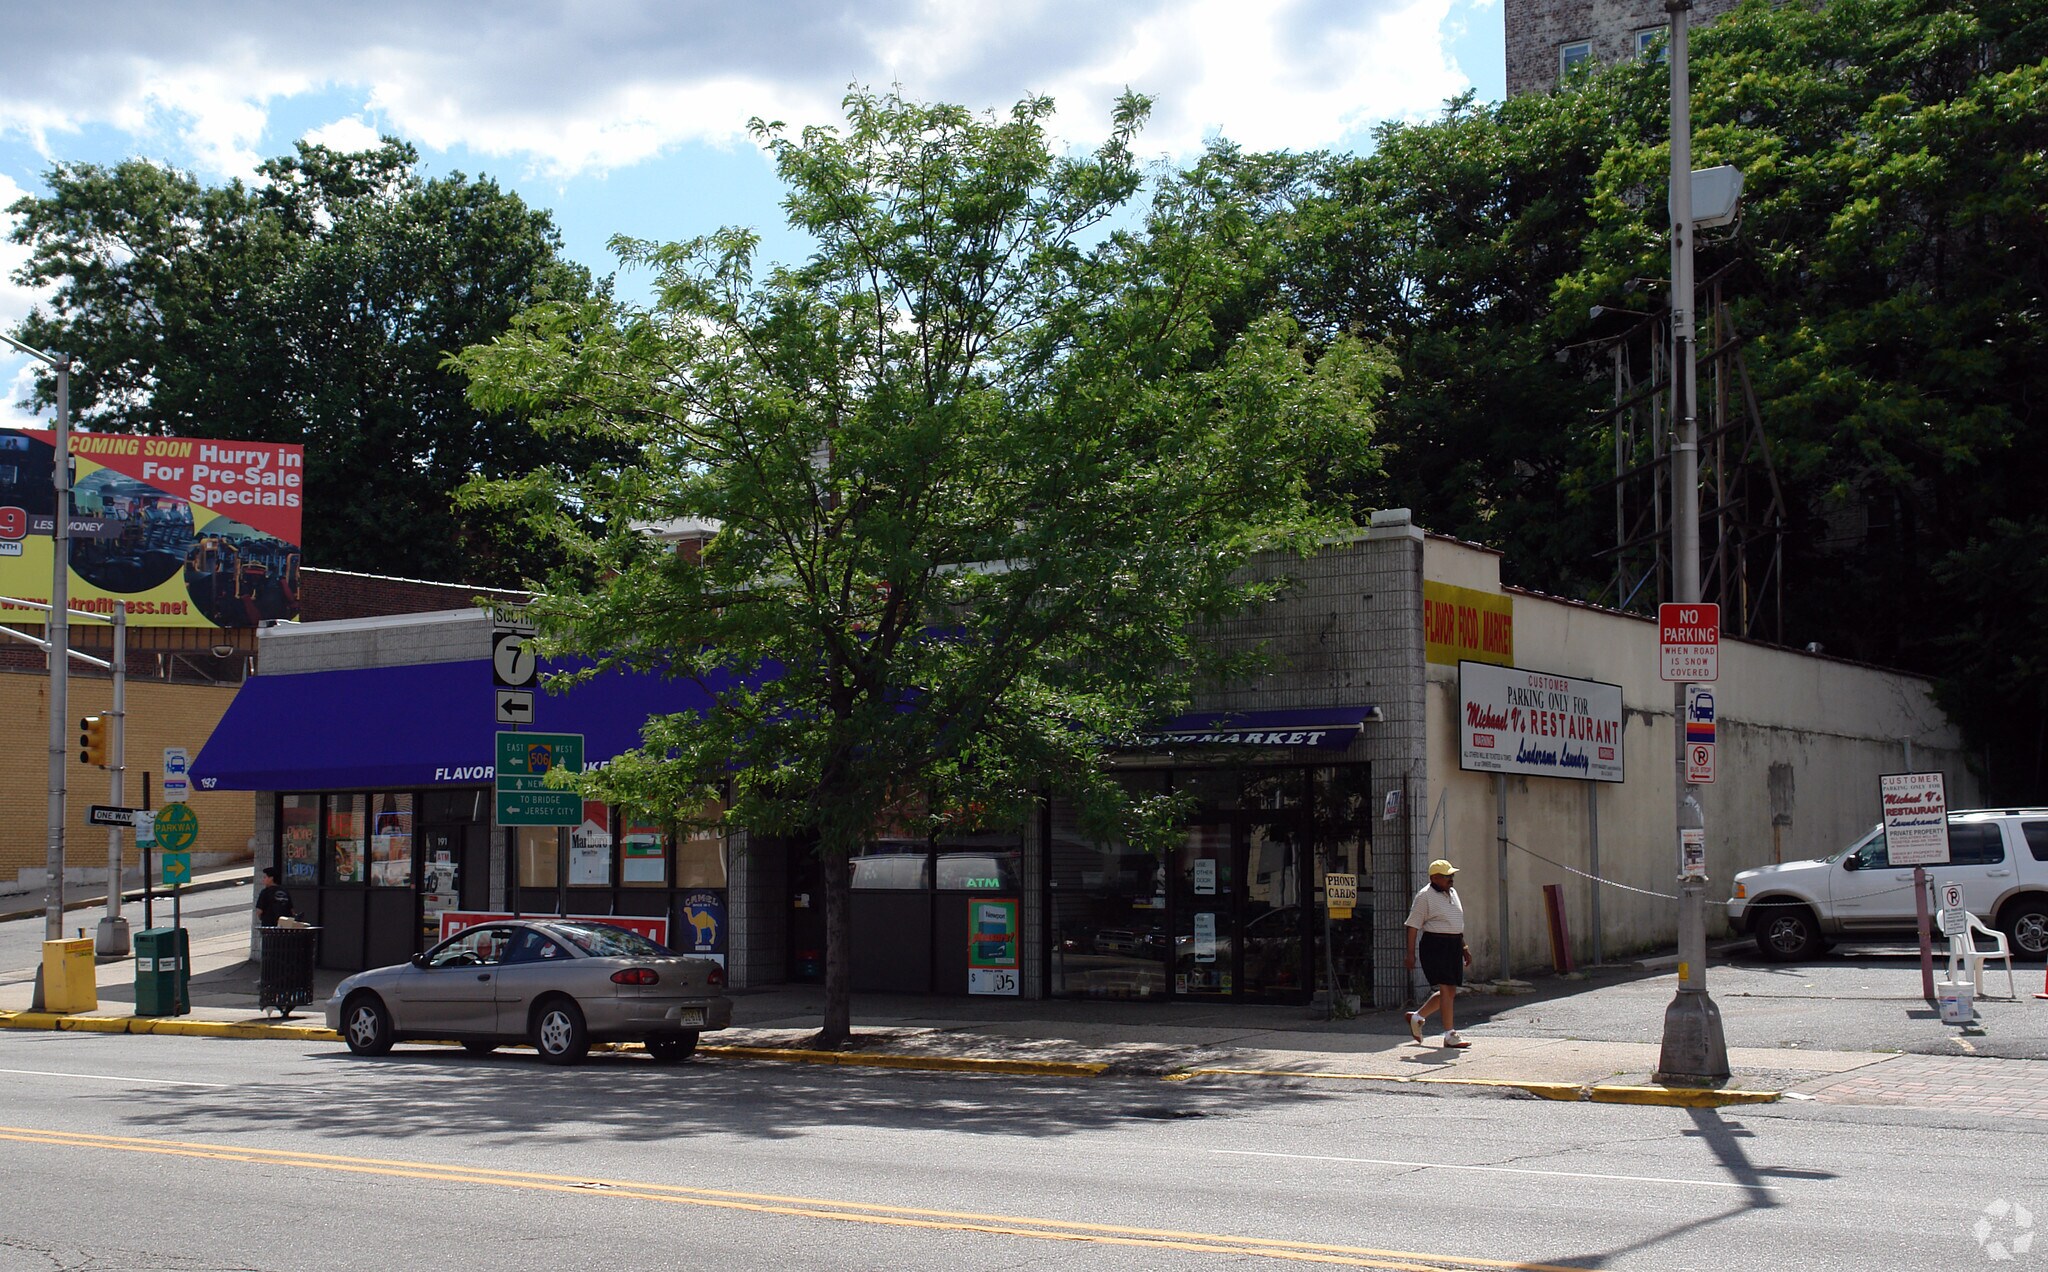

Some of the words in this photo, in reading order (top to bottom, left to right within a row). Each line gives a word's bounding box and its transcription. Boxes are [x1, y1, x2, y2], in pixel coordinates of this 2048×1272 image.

[68, 436, 139, 456] COMING
[144, 440, 192, 458] SOON
[200, 445, 270, 469] Hurry
[278, 448, 301, 467] in
[143, 462, 184, 481] For
[192, 464, 300, 487] Pre-Sale
[190, 484, 300, 508] Specials
[33, 519, 54, 530] LES
[1680, 610, 1698, 624] NO
[1424, 599, 1454, 646] FLAVOR
[1458, 606, 1479, 649] FOOD
[1483, 610, 1512, 655] MARKET
[1664, 627, 1715, 642] PARKING
[1665, 647, 1688, 655] WHEN
[1694, 647, 1715, 655] ROAD
[506, 646, 522, 674] 7
[1685, 658, 1708, 666] SNOW
[1670, 669, 1709, 677] COVERED
[1529, 675, 1568, 693] CUSTOMER
[1507, 686, 1544, 709] PARKING
[1549, 693, 1568, 712] ONLY
[1573, 697, 1588, 715] FOR
[1531, 709, 1618, 745] RESTAURANT
[1197, 731, 1327, 746] MARKET
[506, 744, 524, 752] EAST
[531, 752, 549, 766] 506
[555, 745, 573, 753] WEST
[435, 766, 495, 780] FLAVOR
[201, 777, 217, 788] 193
[1882, 775, 1939, 785] CUSTOMER
[532, 796, 560, 804] BRIDGE
[1884, 793, 1921, 805] Michael
[97, 811, 113, 820] ONE
[115, 813, 131, 821] WAY
[524, 807, 555, 815] JERSEY
[557, 808, 574, 816] CITY
[1885, 805, 1944, 817] RESTAURANT
[155, 823, 196, 833] PARKWAY
[287, 826, 313, 841] Phone
[1913, 828, 1944, 836] PROPERTY
[437, 837, 447, 846] 191
[572, 830, 608, 849] Marlboro
[437, 853, 449, 862] ATM
[966, 878, 1000, 888] ATM
[1328, 876, 1356, 887] PHONE
[1328, 888, 1356, 899] CARDS
[685, 894, 719, 906] CAMEL
[985, 911, 1006, 919] Newport
